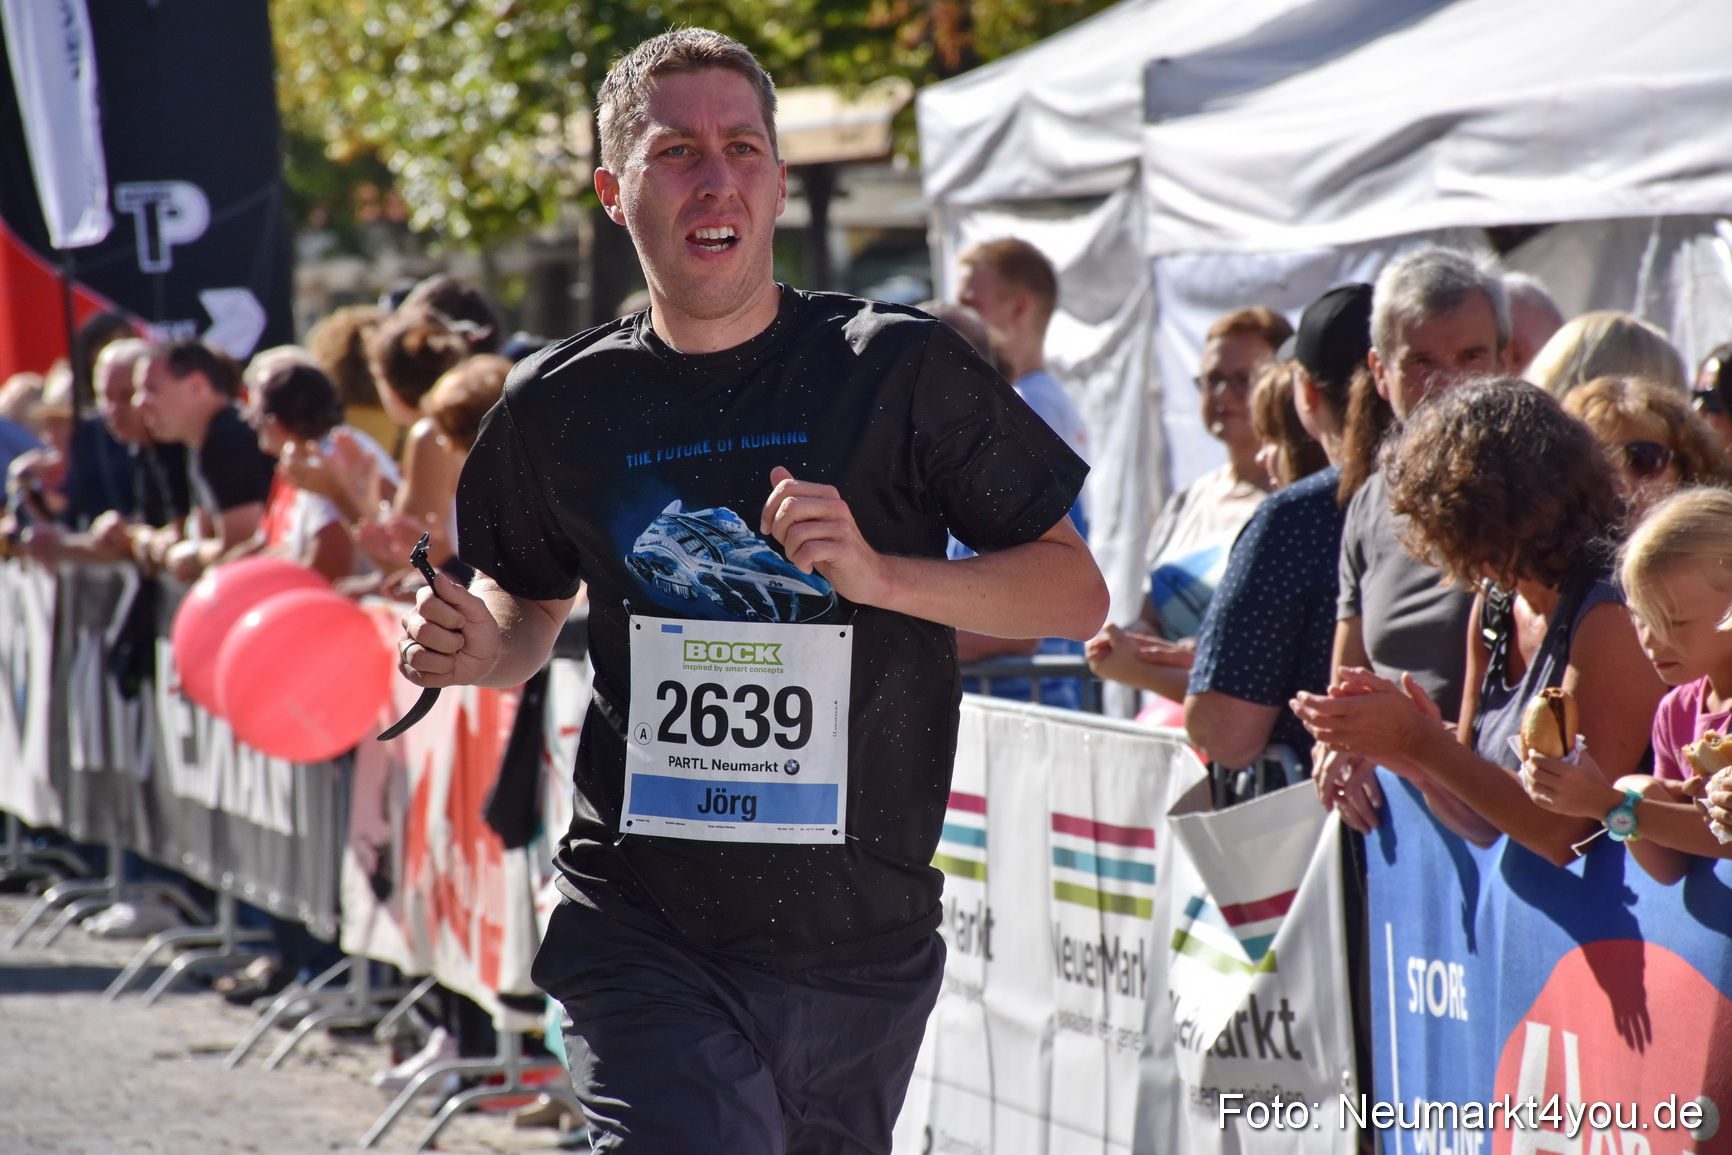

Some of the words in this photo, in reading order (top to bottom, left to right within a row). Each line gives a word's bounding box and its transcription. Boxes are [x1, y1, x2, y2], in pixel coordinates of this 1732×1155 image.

[626, 451, 652, 468] THE
[656, 440, 712, 462] FUTURE
[741, 430, 808, 450] RUNNING
[683, 662, 712, 671] inspired
[714, 664, 723, 672] by
[749, 666, 784, 674] concepts
[684, 640, 783, 665] BOCK
[656, 680, 813, 750] 2639
[668, 755, 708, 770] PARTL
[711, 759, 779, 773] Neumarkt
[697, 787, 757, 822] Jörg
[1407, 956, 1469, 1022] STORE
